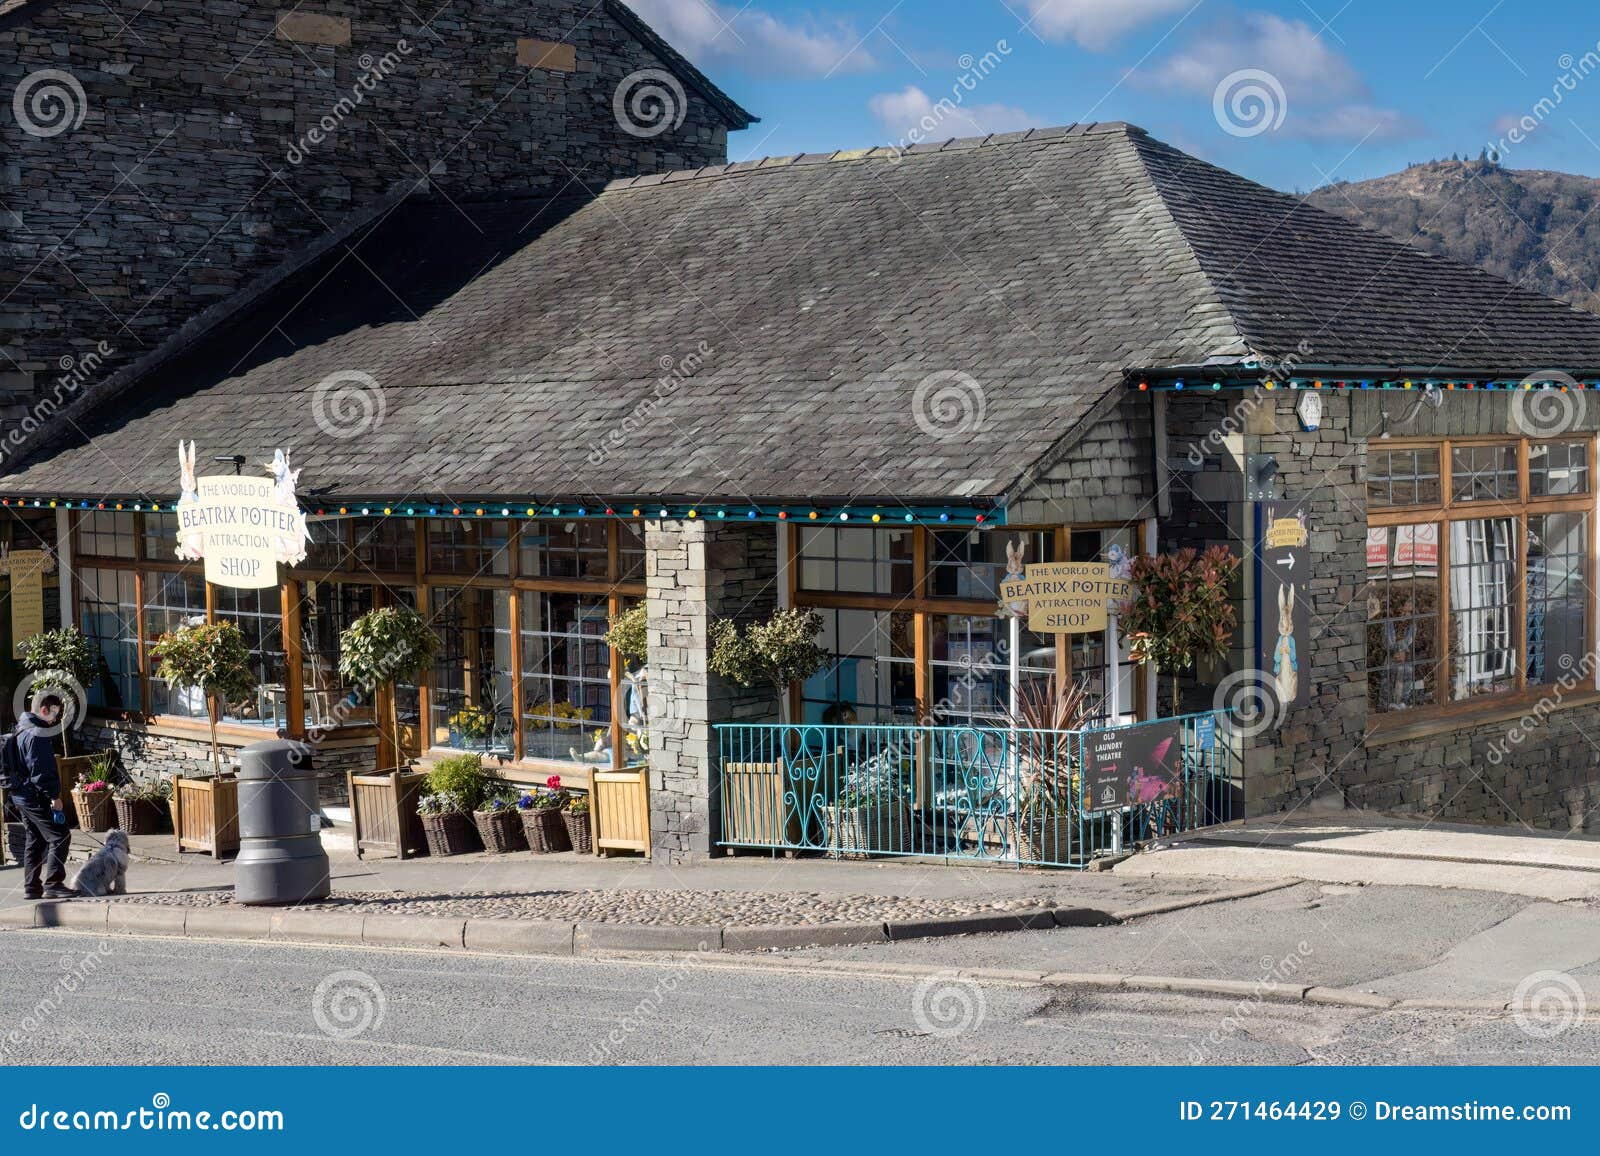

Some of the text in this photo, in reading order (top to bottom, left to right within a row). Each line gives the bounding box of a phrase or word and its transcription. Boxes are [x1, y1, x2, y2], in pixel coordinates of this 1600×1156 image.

[202, 484, 271, 497] THE WORLD OF
[182, 506, 295, 532] BEATRIX POTTER
[209, 534, 270, 548] ATTRACTION
[220, 557, 260, 577] SHOP
[1031, 567, 1105, 577] THE WORLD OF
[1006, 581, 1129, 598] BEATRIX POTTER
[1035, 599, 1101, 609] ATTRACTION
[1046, 613, 1090, 627] SHOP
[1103, 732, 1116, 741] OLD
[1095, 742, 1123, 752] LAUNDRY
[1096, 751, 1122, 762] THEATRE
